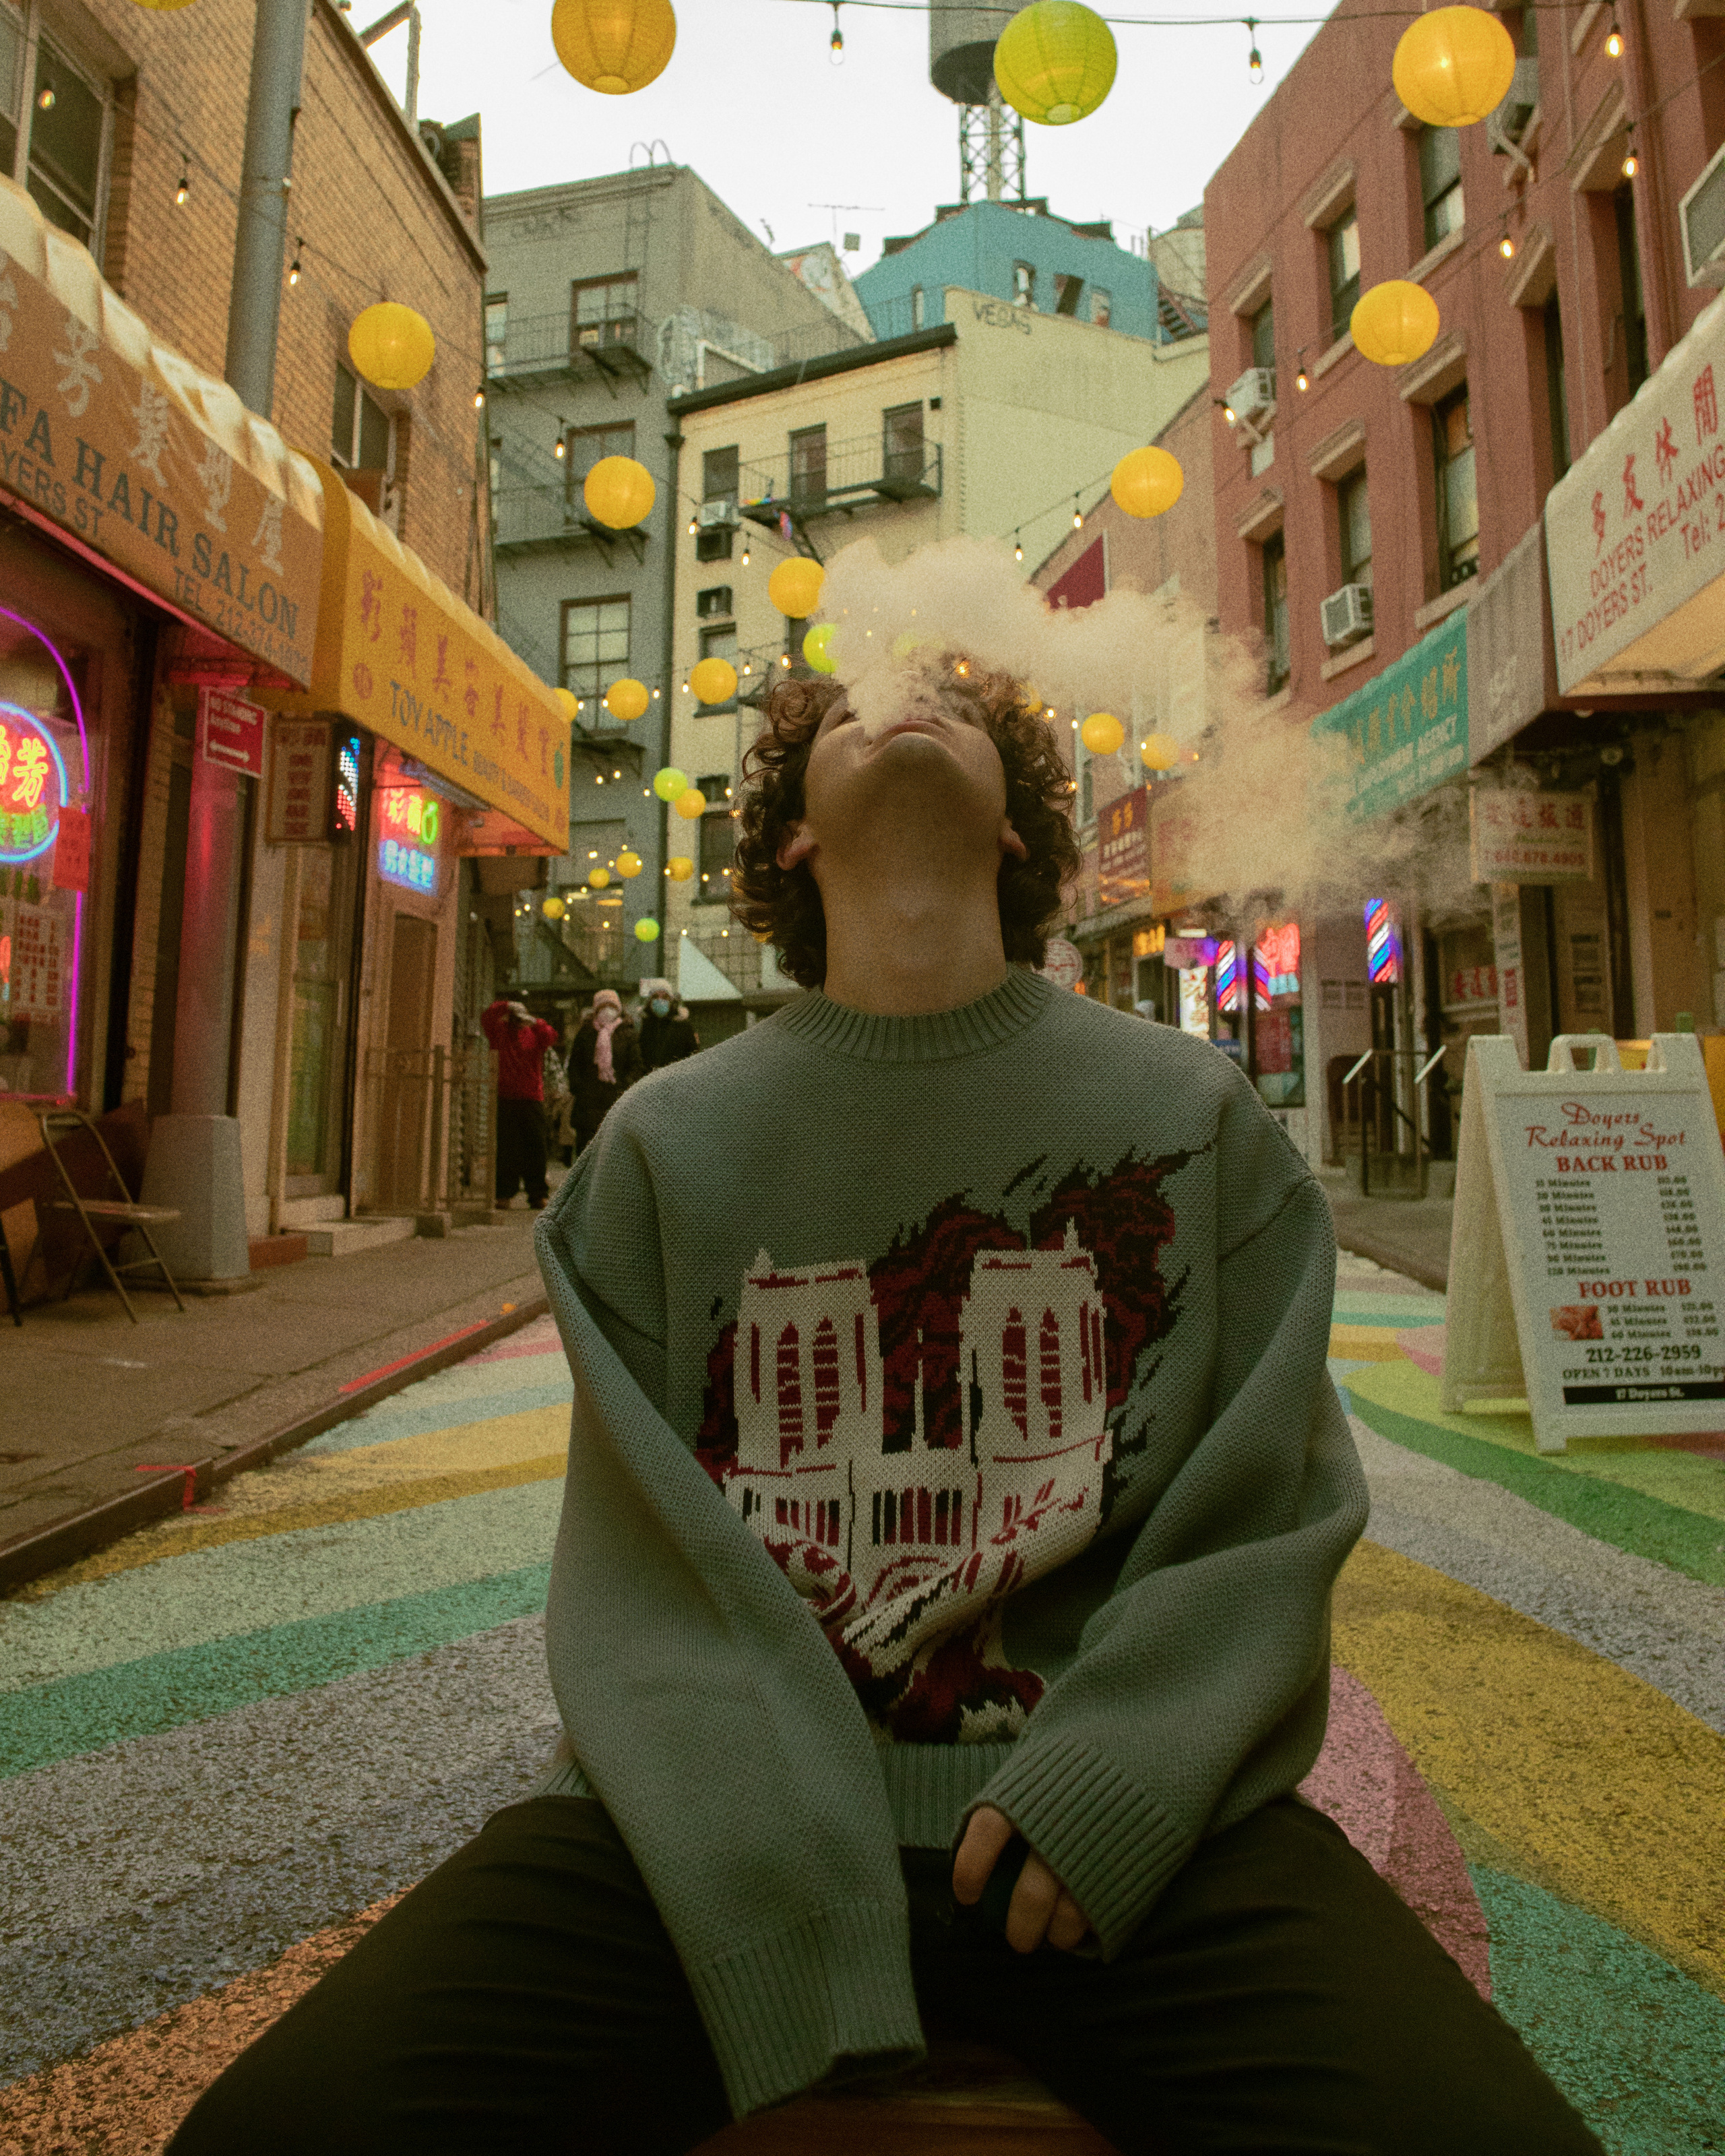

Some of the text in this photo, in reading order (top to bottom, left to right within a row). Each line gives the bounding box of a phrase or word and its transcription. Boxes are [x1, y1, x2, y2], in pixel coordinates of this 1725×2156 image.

[0, 378, 299, 640] FA HAIR SALON
[1590, 445, 1725, 599] DOYERS RELAXING
[1680, 510, 1710, 559] Tel:
[1577, 581, 1630, 650] DOYERS
[1631, 563, 1653, 606] ST.
[390, 678, 468, 766] TOY APPLE
[1561, 1102, 1641, 1129] Doyers
[1524, 1122, 1686, 1151] Relaxing Spot
[1556, 1154, 1668, 1173] BACK RUB
[1548, 1178, 1591, 1188] Minutes
[1551, 1191, 1595, 1200] Minutes
[1554, 1203, 1597, 1212] Minutes
[1555, 1215, 1599, 1224] Minutes
[1559, 1228, 1602, 1238] Minutes
[1559, 1241, 1603, 1250] Minutes
[1563, 1254, 1606, 1263] Minutes
[1567, 1267, 1610, 1275] Minutes
[1578, 1279, 1692, 1299] FOOT RUB
[1623, 1304, 1665, 1312] Minutes
[1625, 1317, 1667, 1325] Minutes
[1628, 1330, 1671, 1339] Minutes
[1586, 1344, 1701, 1363] 212-226-2959
[1563, 1368, 1600, 1380] OPEN
[1614, 1366, 1650, 1378] DAYS
[1628, 1387, 1668, 1401] Doyers
